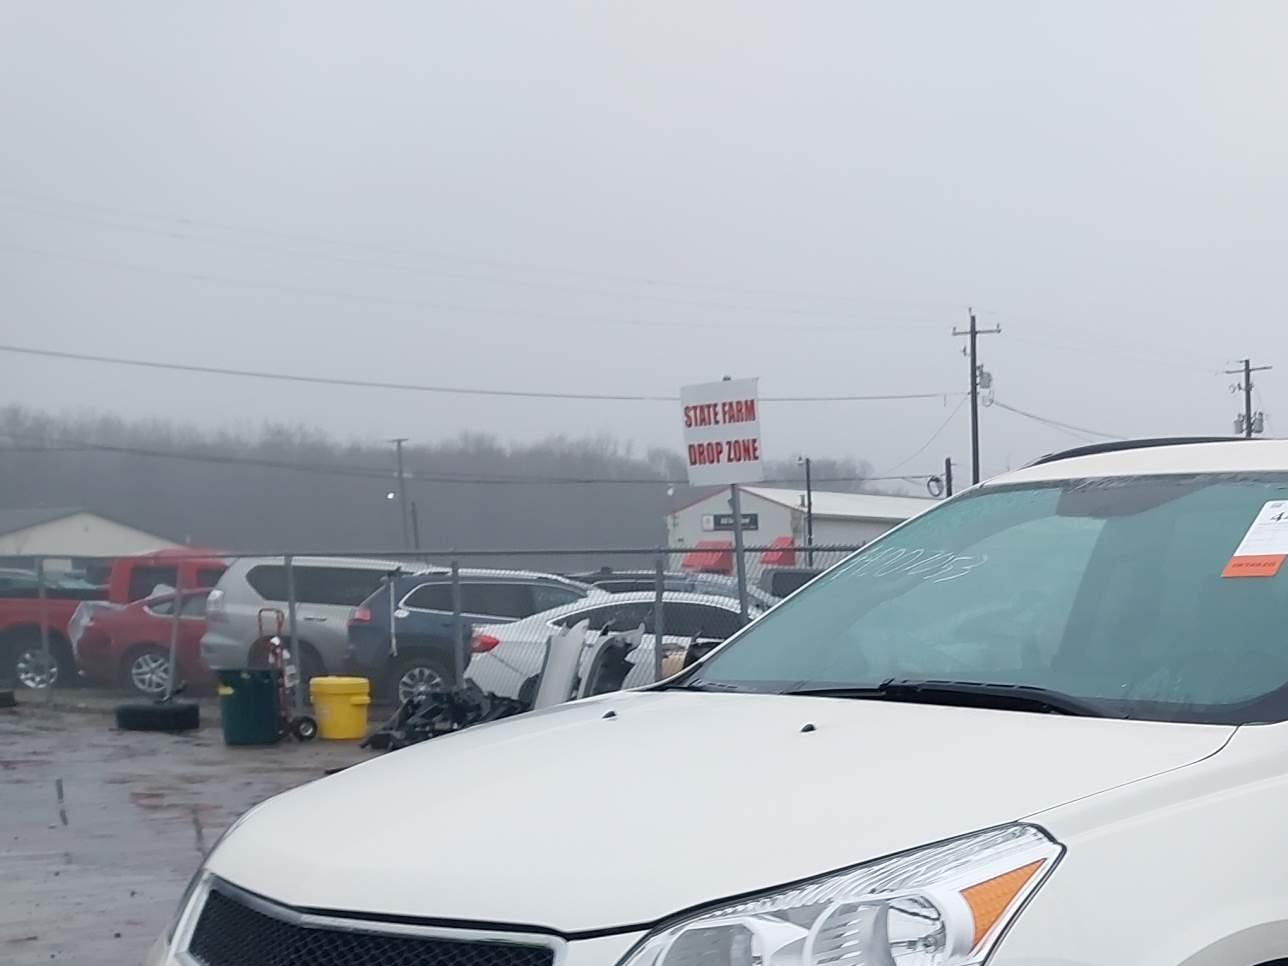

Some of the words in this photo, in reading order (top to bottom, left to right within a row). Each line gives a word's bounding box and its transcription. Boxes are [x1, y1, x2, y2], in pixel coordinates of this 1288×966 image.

[684, 402, 719, 428] STATE
[721, 399, 756, 424] FARM
[688, 441, 723, 466] DROP
[726, 438, 759, 463] ZONE
